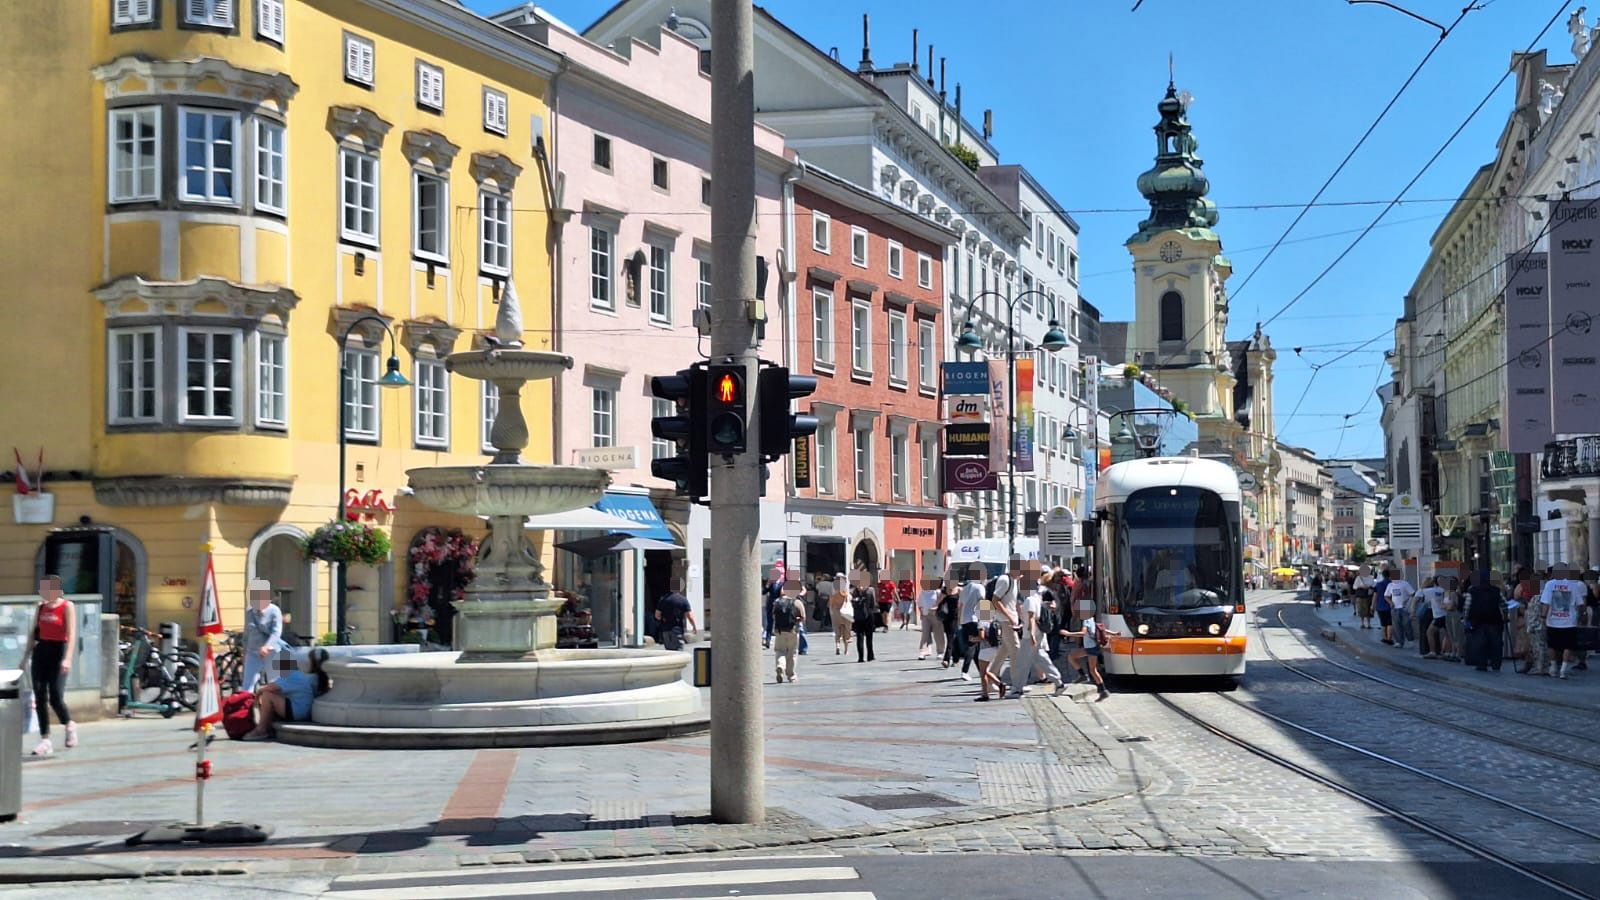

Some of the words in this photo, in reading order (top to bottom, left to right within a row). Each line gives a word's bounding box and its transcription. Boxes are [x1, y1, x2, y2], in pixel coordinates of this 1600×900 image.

[1561, 239, 1593, 250] HOLY
[1516, 286, 1543, 296] HOLY
[945, 372, 988, 380] BIOGEN
[956, 400, 978, 412] dm
[948, 432, 992, 443] HUMANI
[581, 453, 632, 464] BIOGENA
[1135, 500, 1146, 511] 2
[902, 524, 935, 537] intimissimi
[960, 545, 979, 553] GLS
